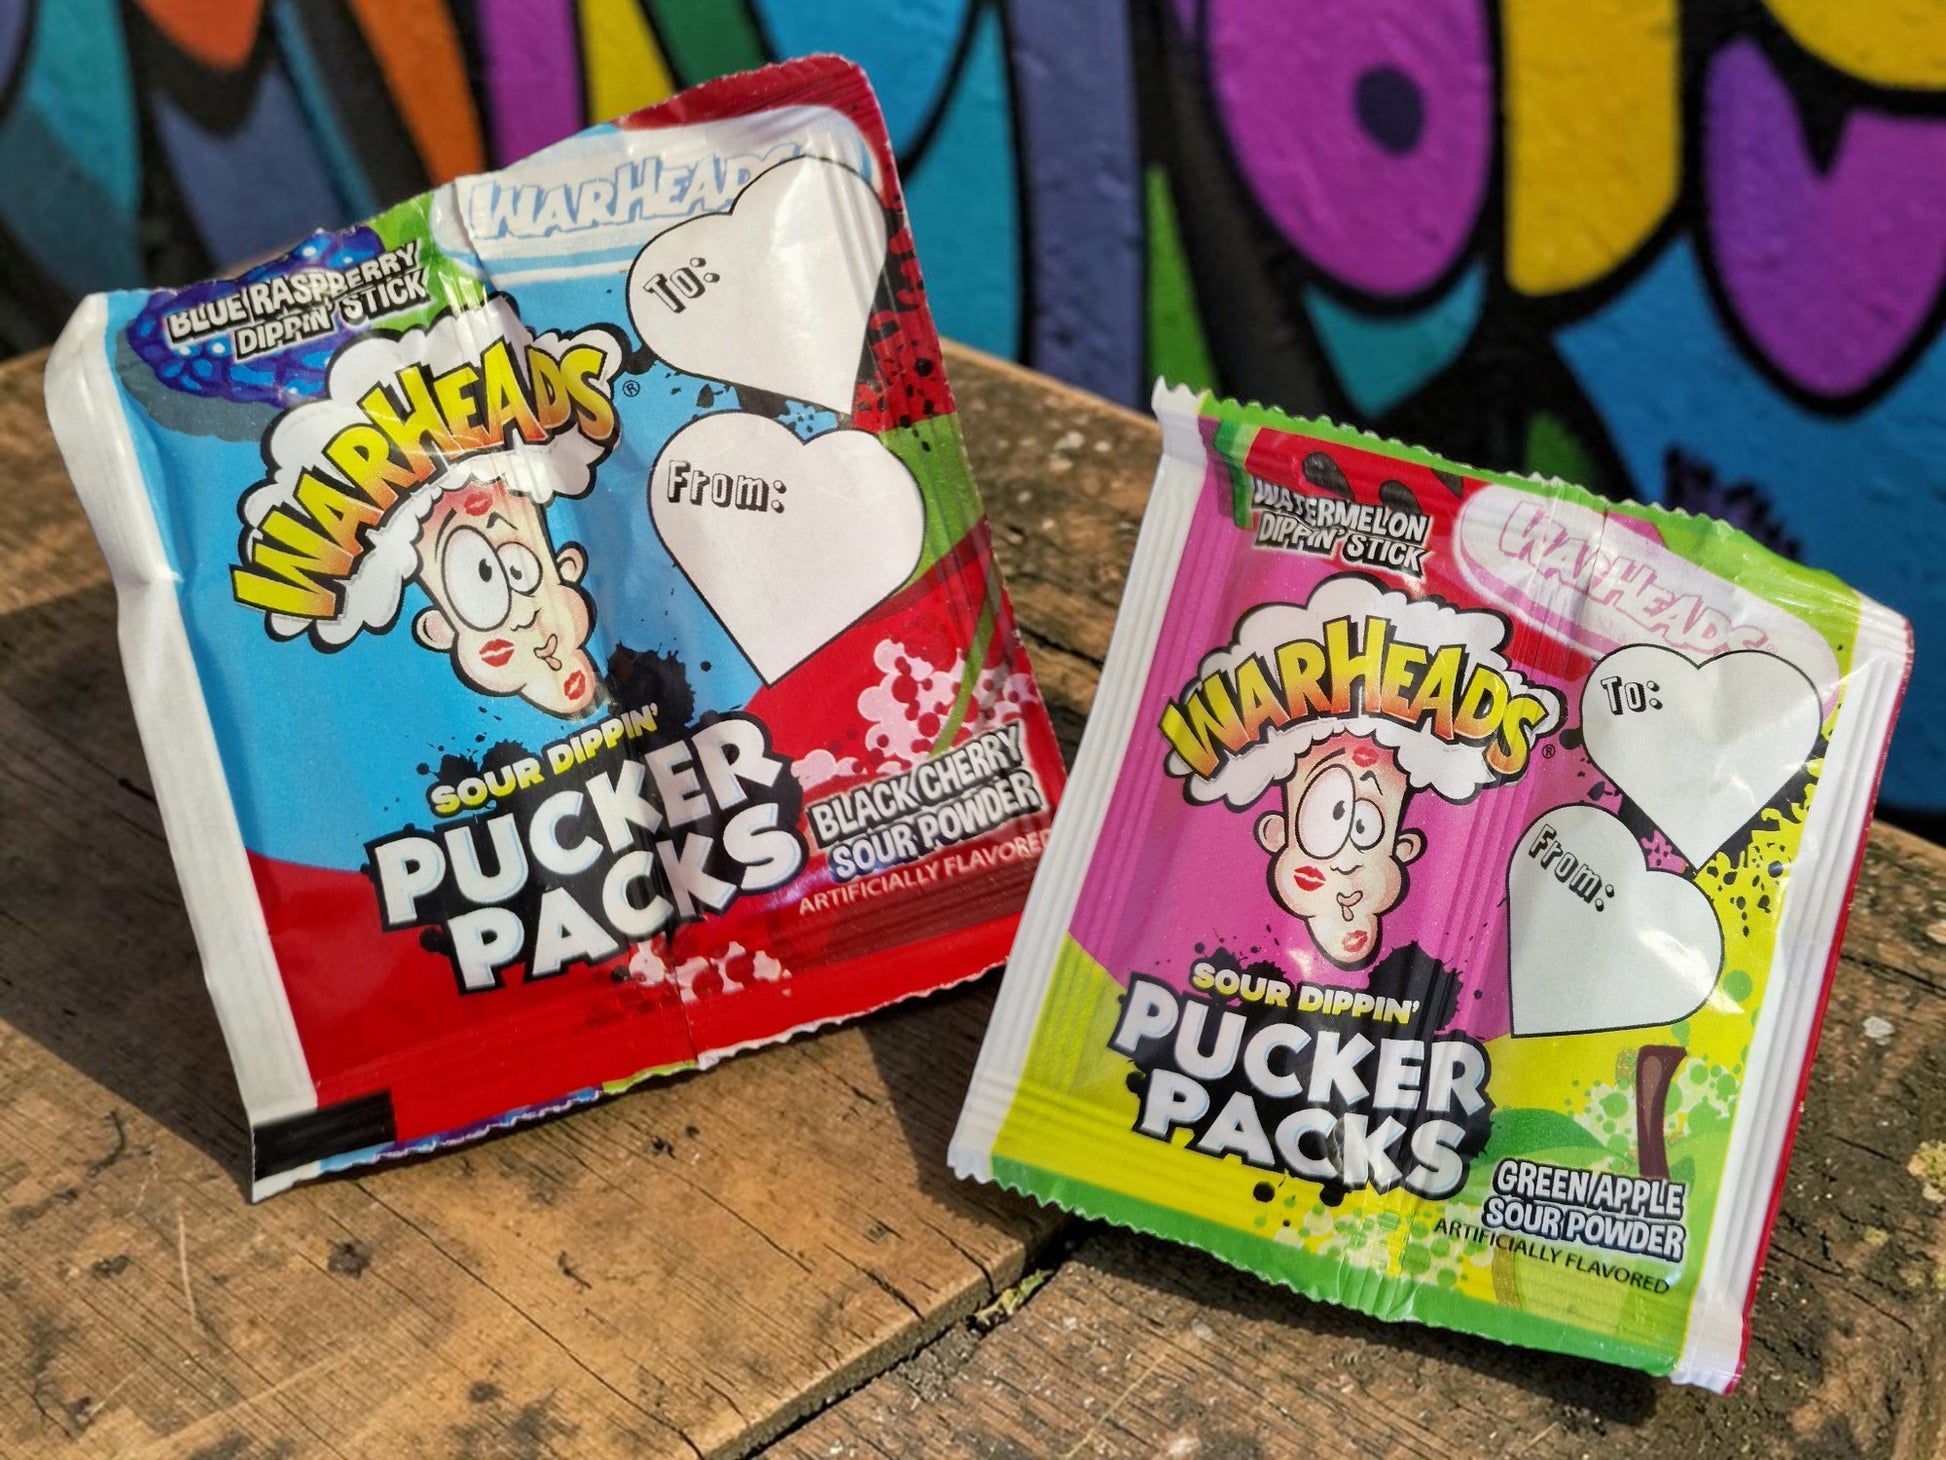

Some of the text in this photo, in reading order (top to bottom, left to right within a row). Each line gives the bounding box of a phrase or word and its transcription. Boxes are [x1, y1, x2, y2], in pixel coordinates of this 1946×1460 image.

[470, 143, 802, 239] WARHEAD
[168, 241, 418, 340] BLUE RASPBERRY
[234, 269, 430, 357] DIPPIN' STICK
[643, 256, 721, 314] To:
[230, 340, 616, 621] WARHEADS
[667, 459, 788, 514] From:
[1253, 479, 1428, 543] WATERMELON
[1257, 511, 1426, 574] DIPPIN' STICK
[1157, 614, 1549, 782] WARHEADS
[1601, 676, 1664, 715] To:
[430, 703, 659, 816] SOUR DIPPIN'
[809, 724, 1023, 841] BLACK CHERRY
[372, 719, 785, 927] PUCKER
[831, 770, 1044, 879] SOUR POWDER
[1529, 823, 1615, 913] From:
[446, 803, 803, 992] PACKS
[799, 858, 941, 915] ARTIFICIALLY
[1191, 961, 1421, 1024] SOUR DIPPIN'
[1112, 978, 1488, 1117] PUCKER
[1140, 1067, 1467, 1199] PACKS
[1484, 1199, 1686, 1262] SOUR POWDER
[1495, 1160, 1684, 1220] GREEN APPLE
[1434, 1217, 1670, 1295] ARTIFICIALLY FLAVORED
